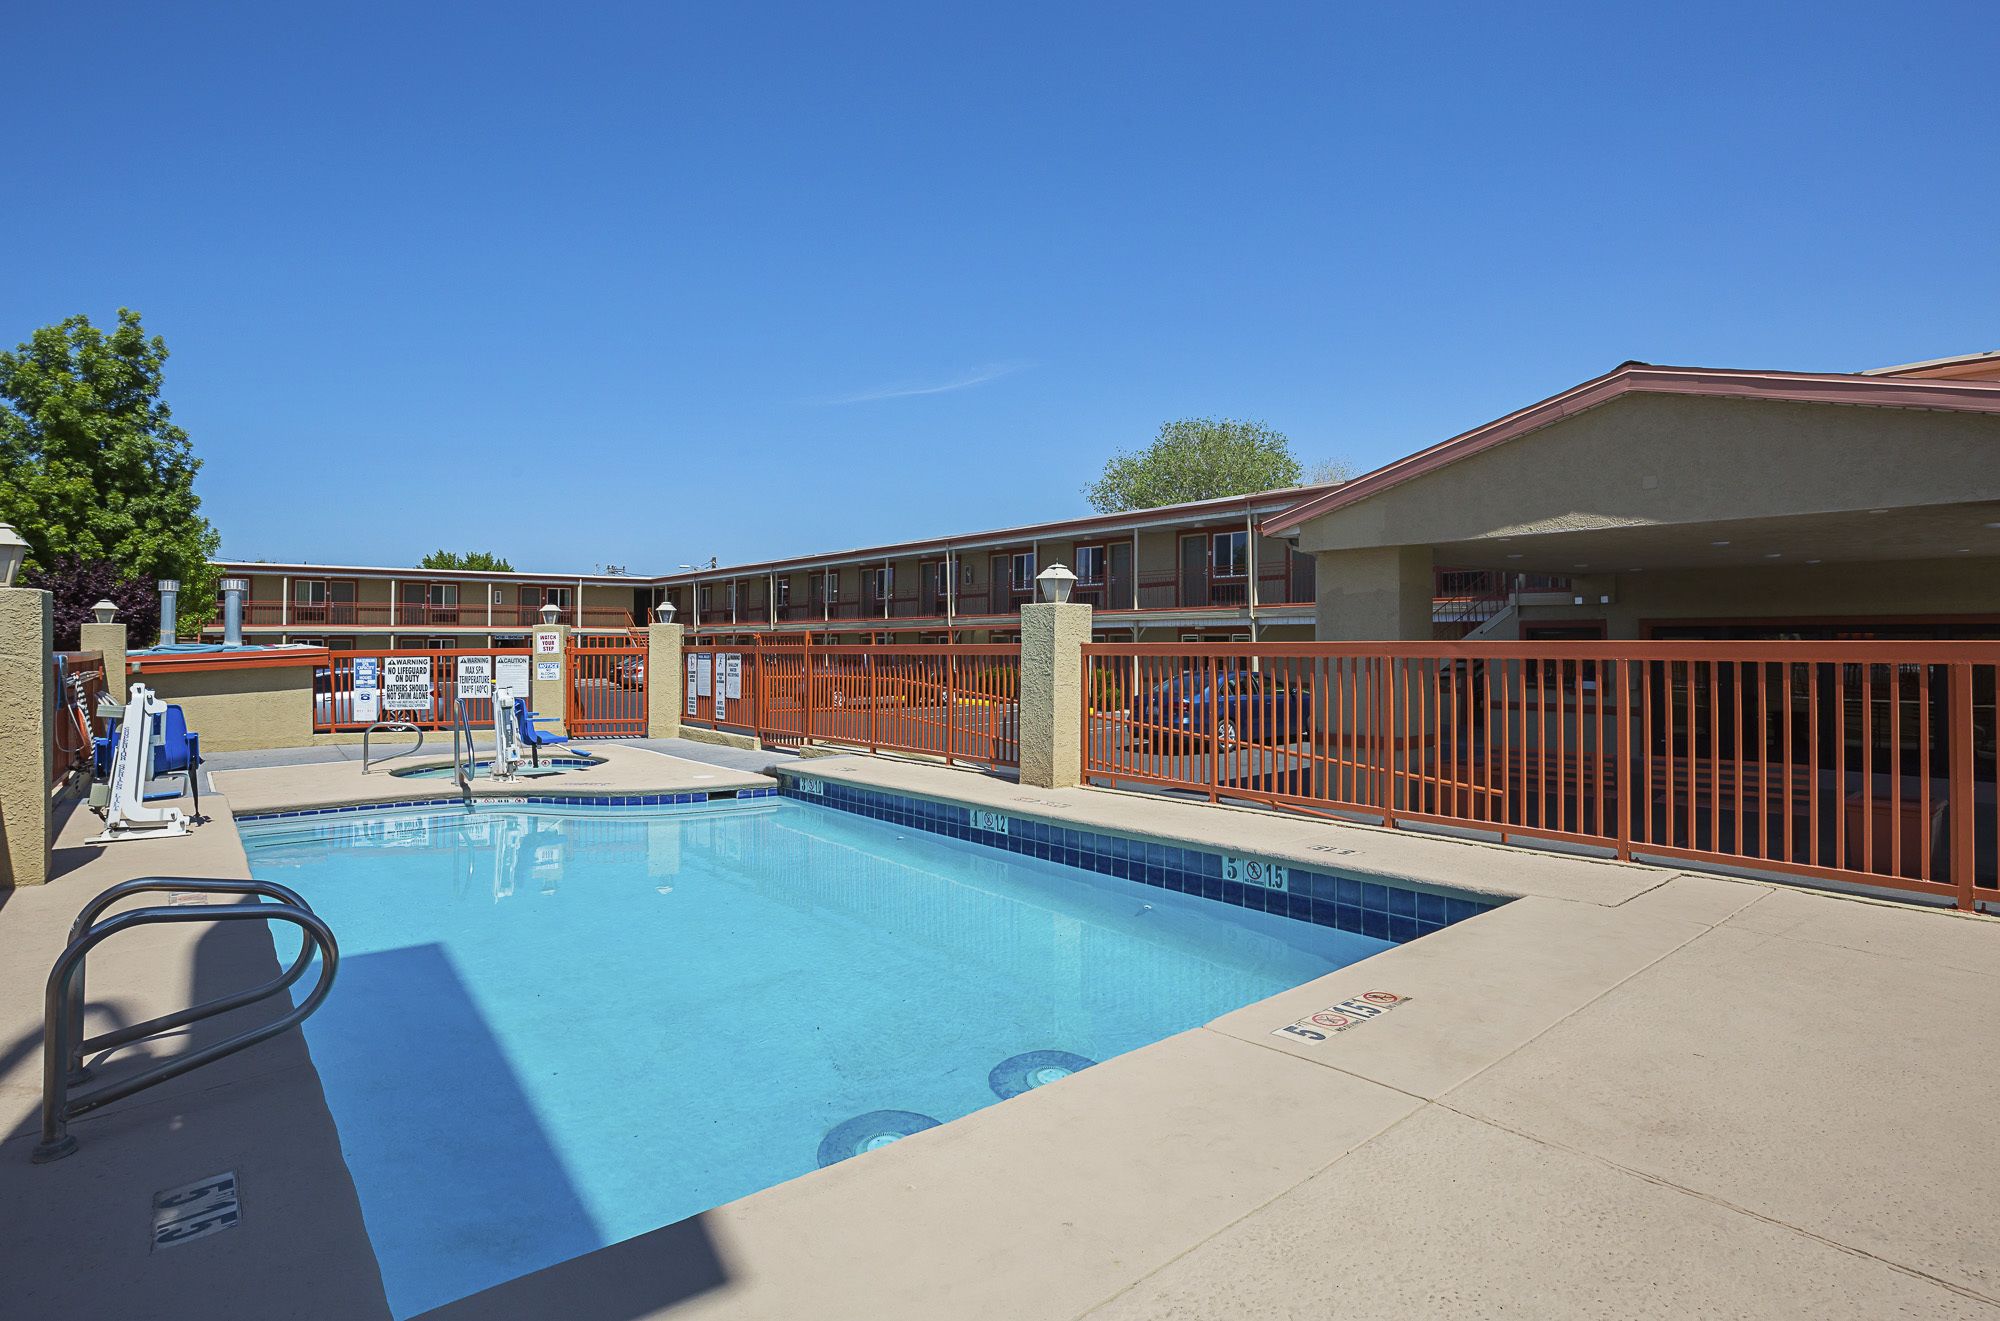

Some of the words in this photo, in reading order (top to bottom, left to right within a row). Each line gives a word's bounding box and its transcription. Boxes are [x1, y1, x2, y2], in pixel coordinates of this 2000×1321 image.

[387, 667, 396, 675] NO
[397, 667, 428, 675] LIFEGUARD
[465, 666, 475, 674] MAX
[475, 666, 484, 674] SPA
[459, 675, 490, 684] TEMPERATURE
[386, 684, 408, 692] BATHERS
[972, 810, 978, 826] 4
[996, 814, 1005, 832] 1.2
[1228, 857, 1238, 879] 5
[1266, 863, 1284, 889] 1.5
[1283, 1025, 1326, 1041] 5
